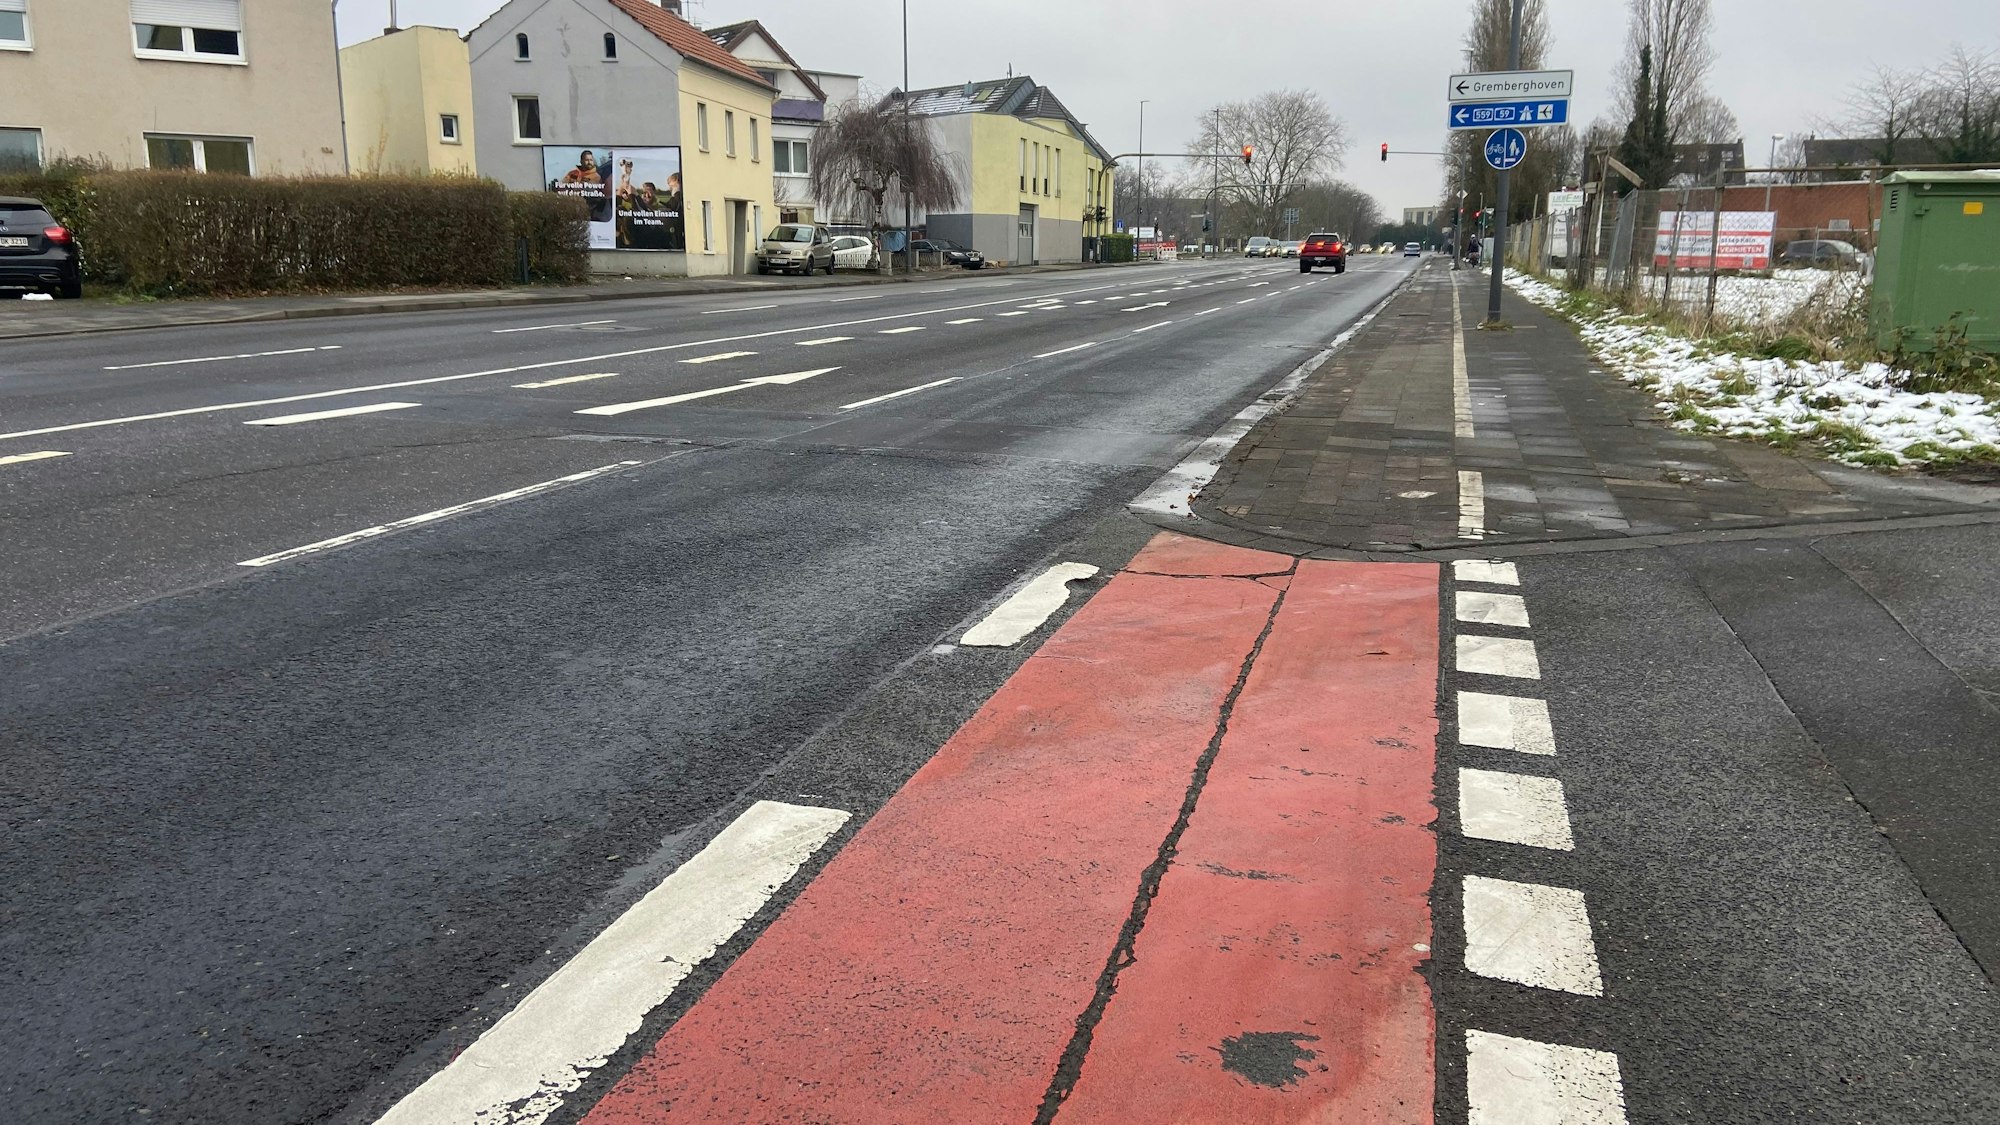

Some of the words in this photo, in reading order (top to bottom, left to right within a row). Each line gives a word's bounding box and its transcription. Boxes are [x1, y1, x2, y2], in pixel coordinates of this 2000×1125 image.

[1473, 80, 1564, 92] Gremberghoven
[1475, 110, 1491, 119] 559
[1499, 109, 1510, 118] 59
[555, 181, 566, 189] Für
[566, 181, 584, 189] volle
[558, 189, 569, 197] auf
[569, 189, 580, 197] der
[580, 189, 605, 197] Straße.
[654, 210, 679, 218] Einsatz
[643, 218, 664, 226] Team.
